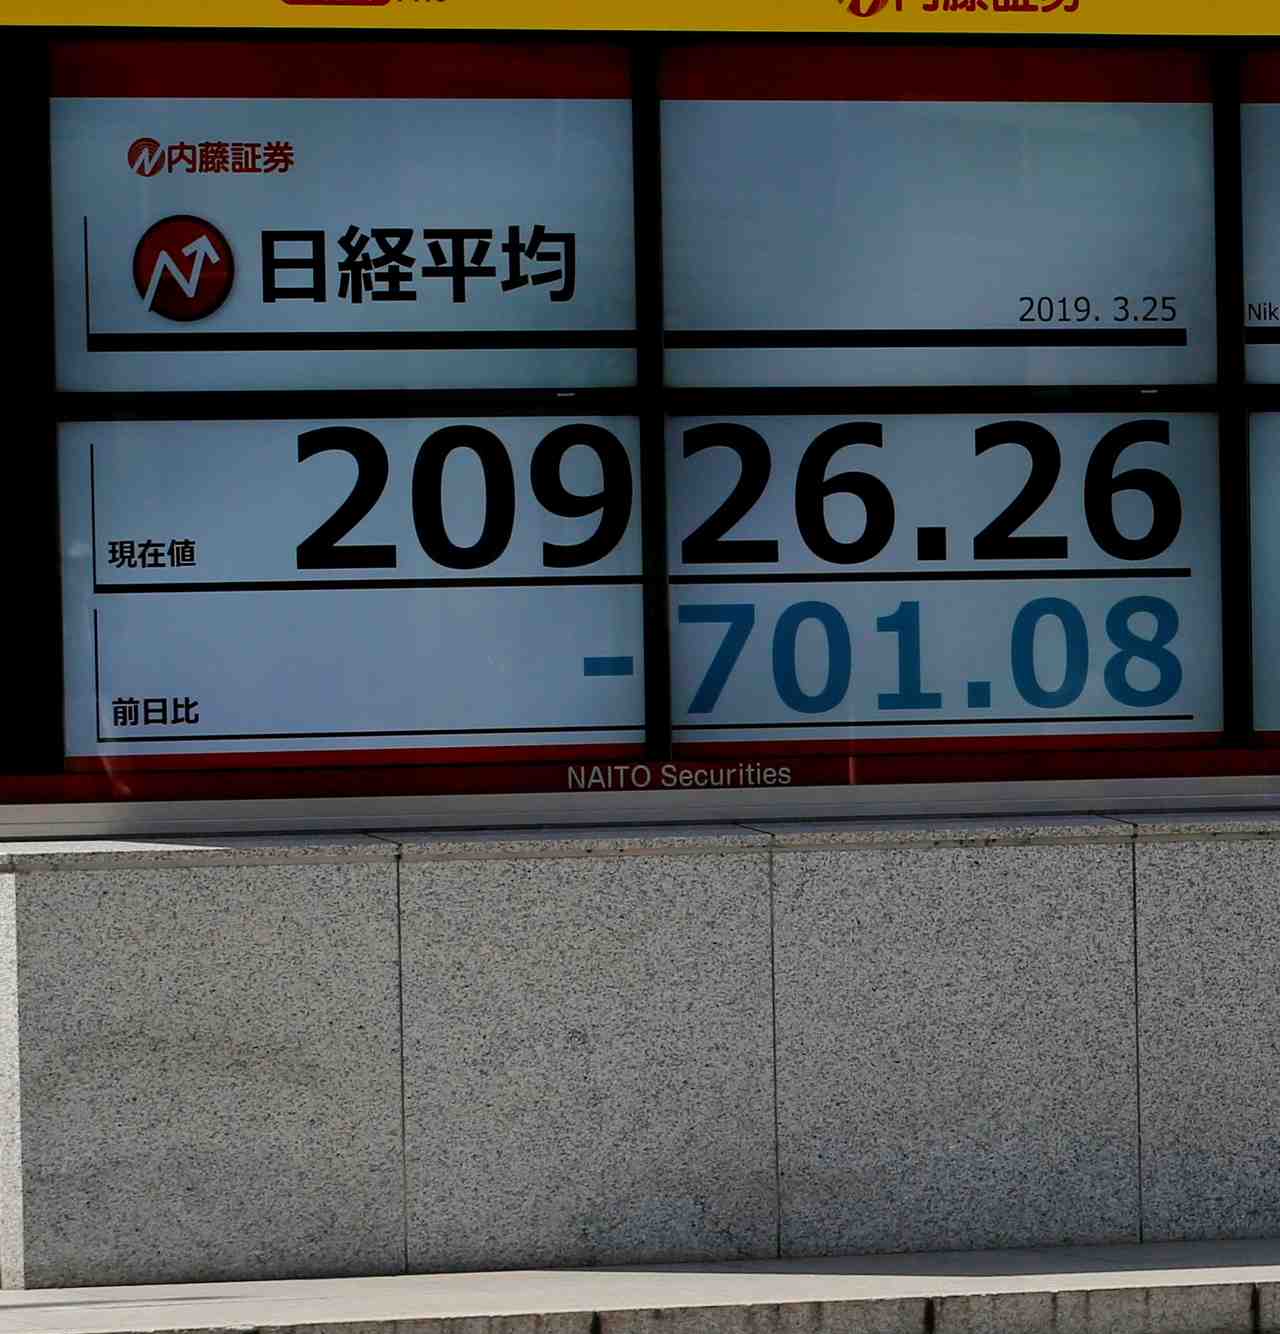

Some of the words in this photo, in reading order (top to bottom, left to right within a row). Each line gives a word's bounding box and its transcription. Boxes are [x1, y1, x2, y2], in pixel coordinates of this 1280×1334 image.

[167, 141, 295, 174] 内藤証券
[261, 224, 577, 303] 日経平均
[108, 539, 197, 568] 現在値
[112, 696, 200, 726] 前日比
[568, 764, 651, 790] NAITO
[661, 762, 792, 787] Securities
